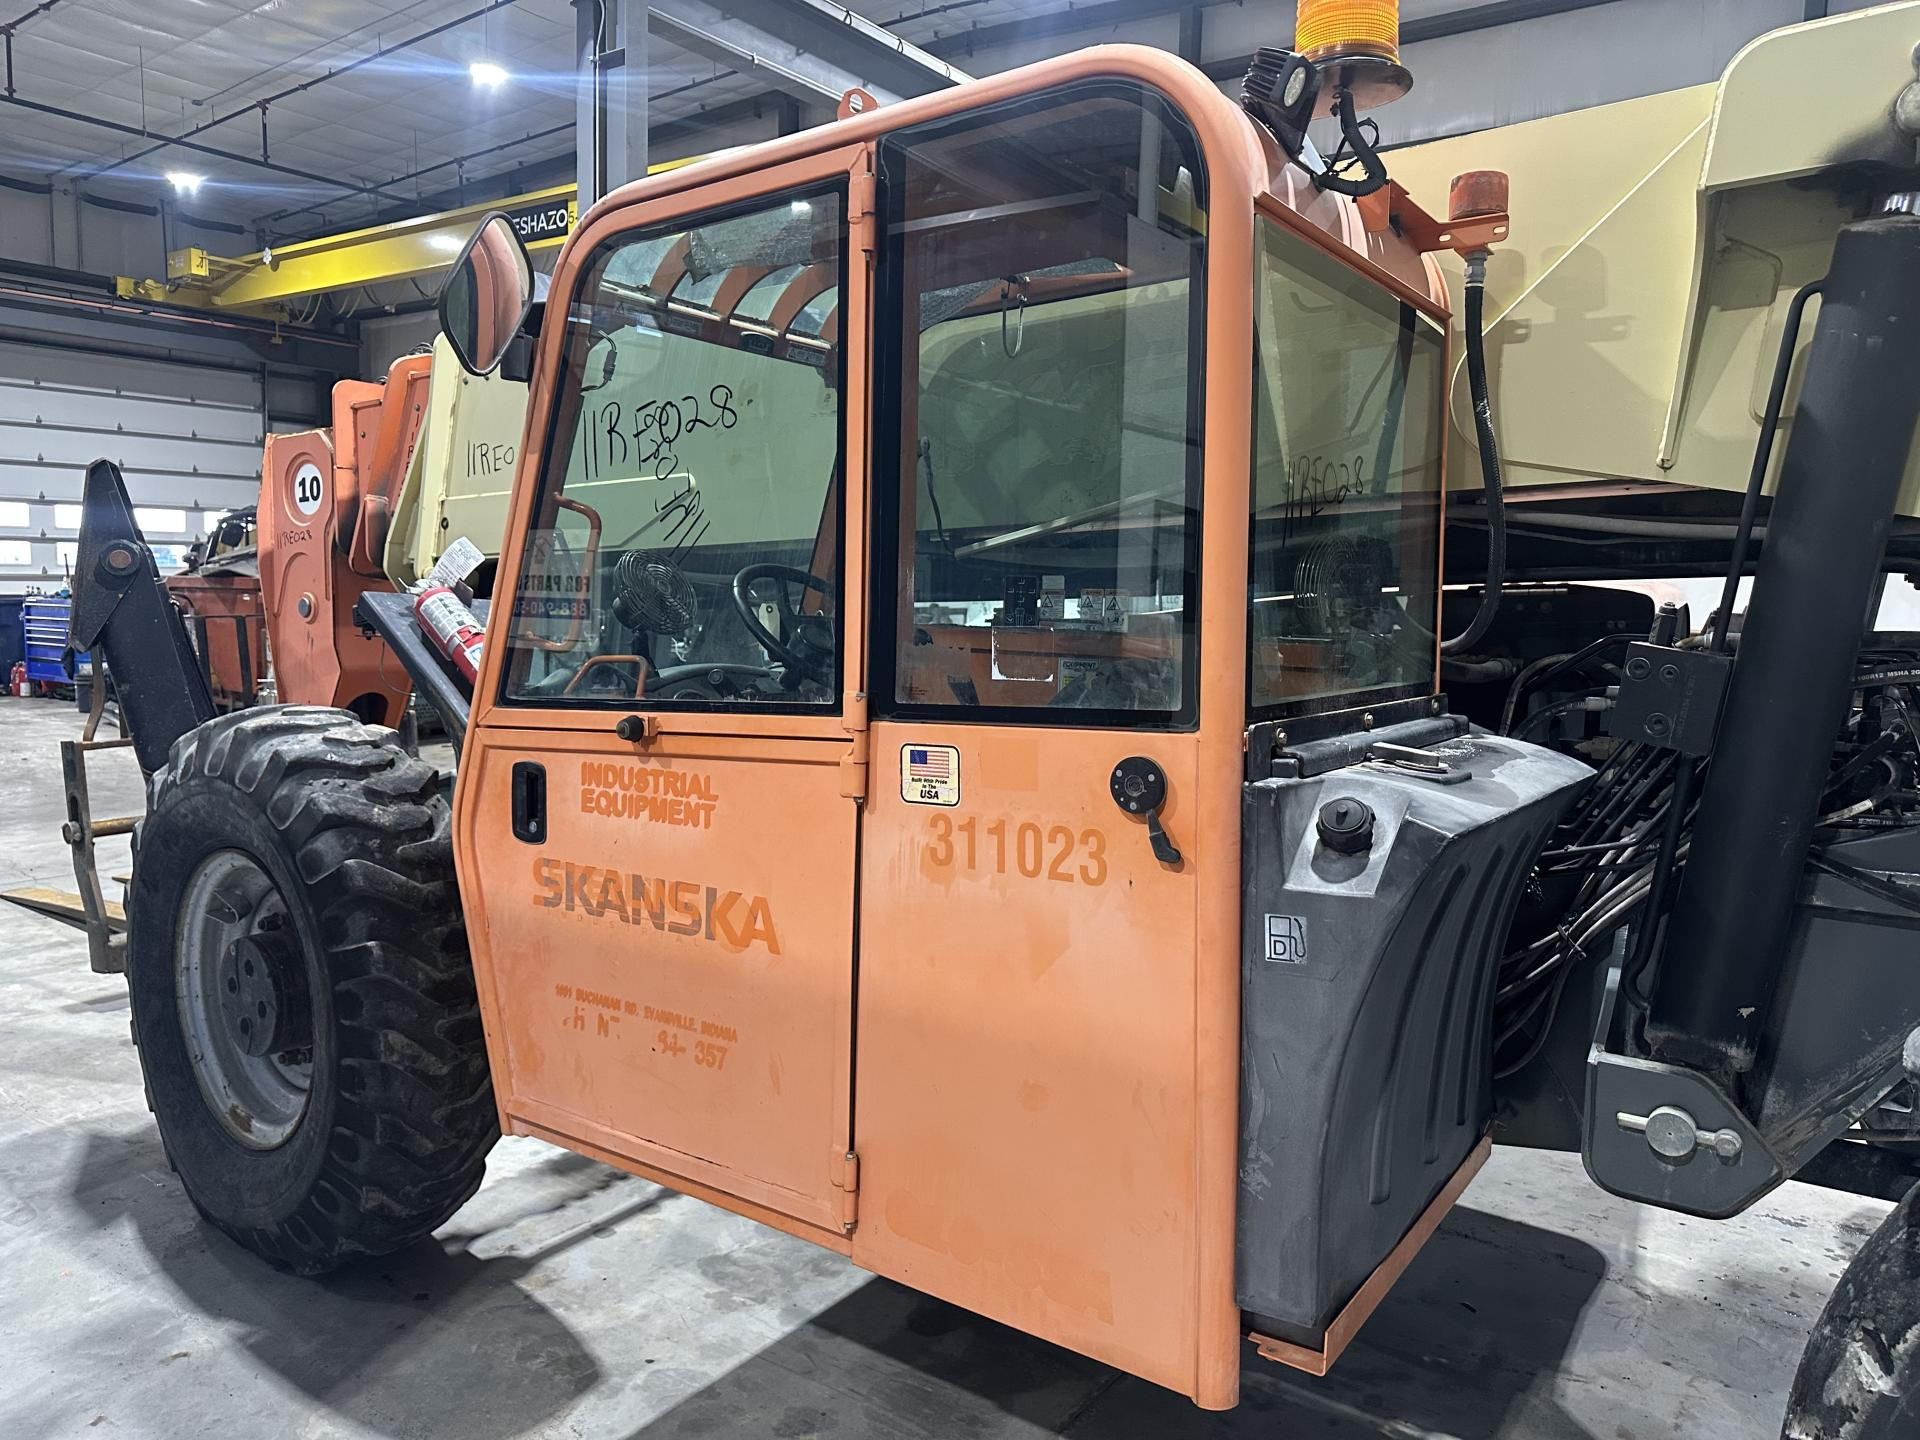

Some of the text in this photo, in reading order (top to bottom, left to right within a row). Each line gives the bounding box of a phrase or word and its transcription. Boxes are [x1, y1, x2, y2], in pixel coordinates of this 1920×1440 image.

[583, 384, 738, 481] 11RE028
[298, 475, 321, 503] 10
[1282, 455, 1364, 549] 11RE028
[580, 761, 719, 803] INDUSTRIAL
[580, 787, 717, 830] EQUIPMENT
[920, 789, 939, 801] USA
[928, 812, 1108, 887] 311023
[532, 856, 782, 956] SKANSKA
